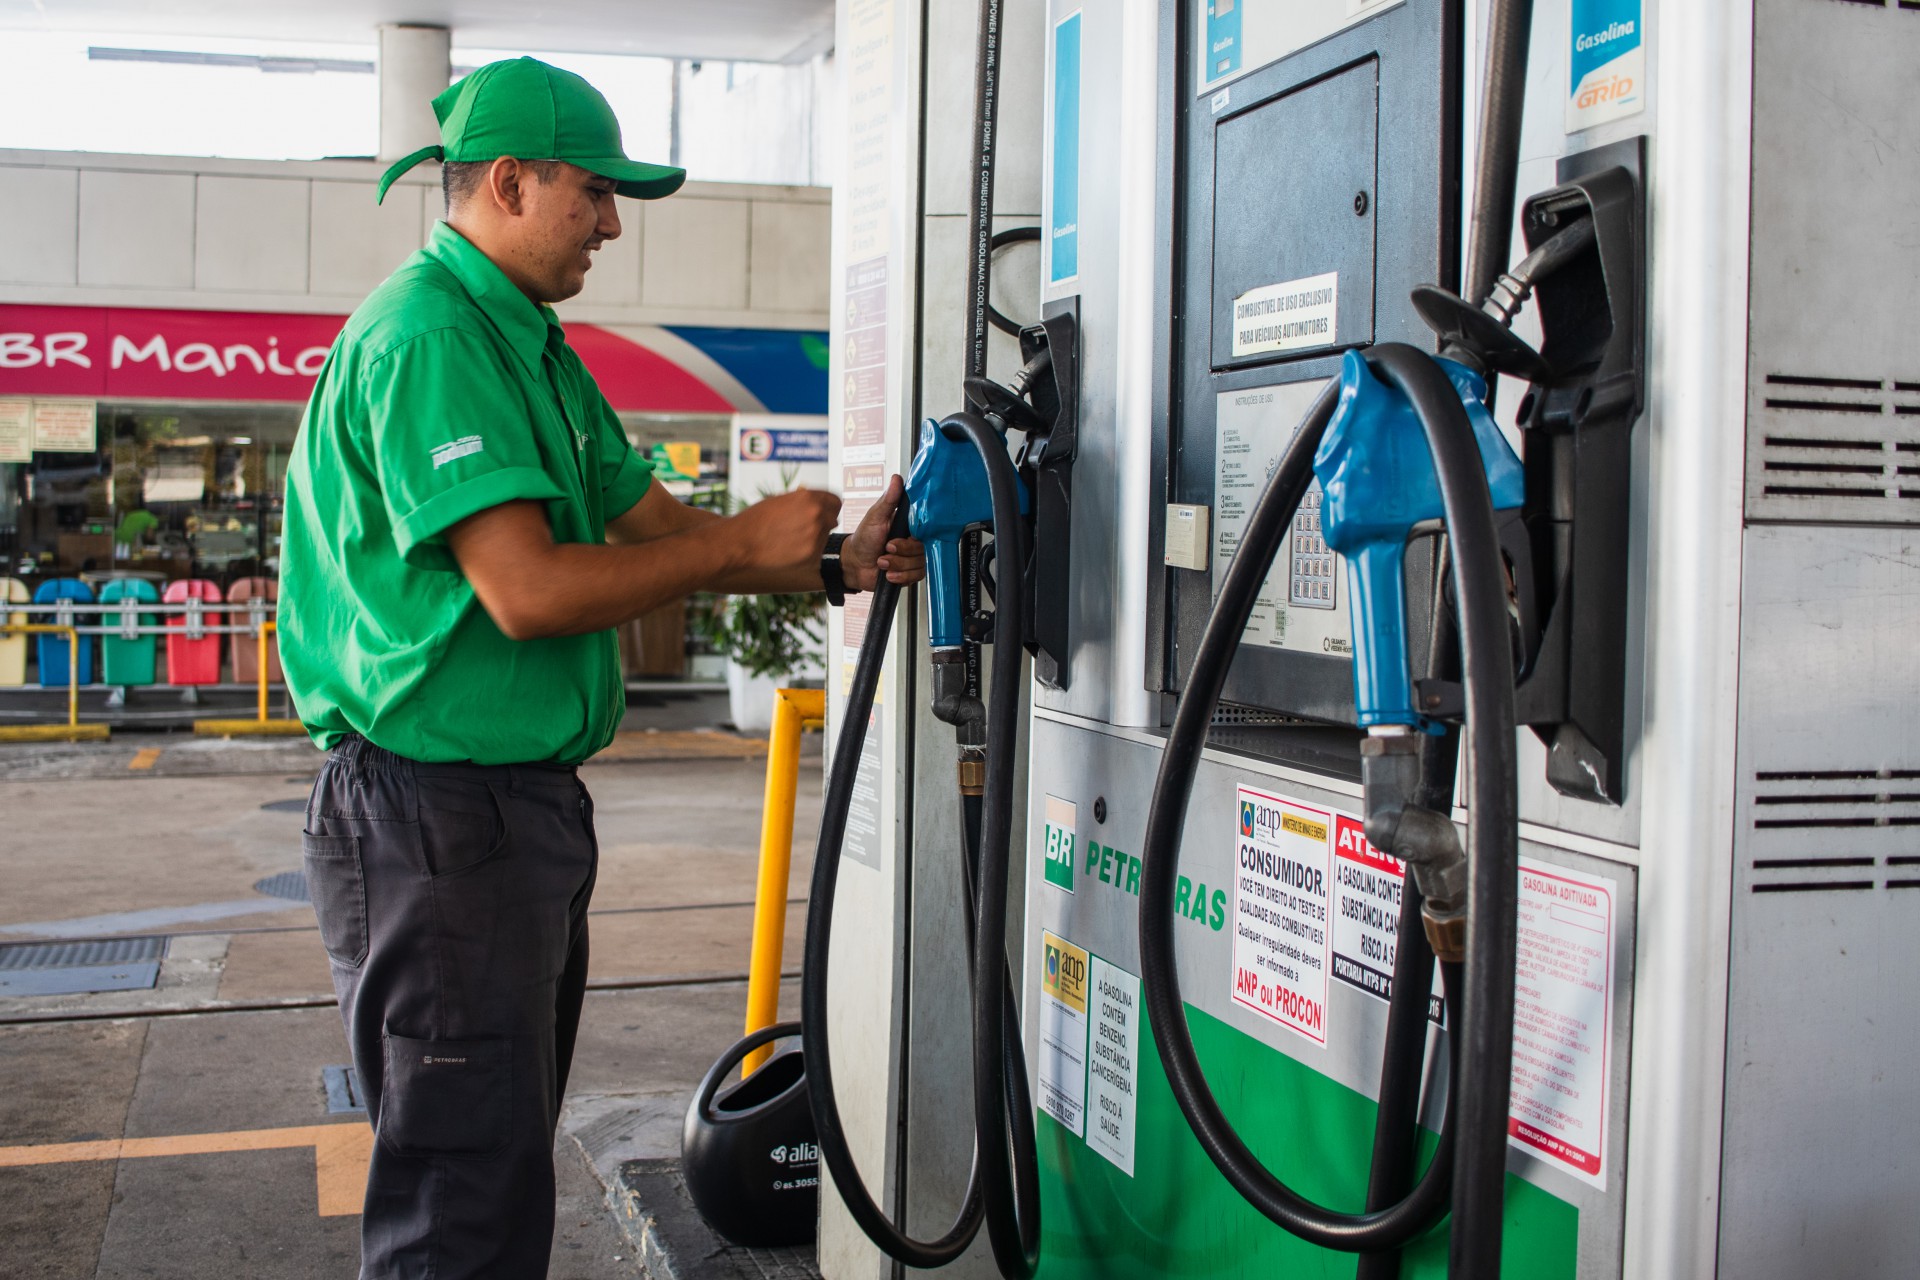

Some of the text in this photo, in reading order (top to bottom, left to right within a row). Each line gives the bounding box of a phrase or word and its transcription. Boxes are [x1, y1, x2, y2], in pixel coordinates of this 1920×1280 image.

[1576, 20, 1635, 52] Gasolina
[982, 121, 992, 152] BOMBA
[982, 155, 990, 167] DE
[1054, 222, 1077, 239] Gasolina
[1237, 288, 1333, 319] COMBUSTÍVEL DE USO EXCLUSIVO
[1239, 317, 1328, 345] PARA VEÍCULOS AUTOMOTORES
[1256, 804, 1281, 838] anp
[1045, 826, 1227, 932] BR PETRRAS
[1240, 844, 1326, 897] CONSUMIDOR.
[1337, 864, 1402, 905] A GASOLINA CONTÉ
[1240, 876, 1325, 921] VOCÊ TEM DIREITO AO TESTE DE
[1522, 876, 1597, 908] GASOLINA ADITIVADA
[1239, 899, 1324, 946] QUALIDADE DOS COMBUSTÍVEIS
[1341, 896, 1383, 929] SUBSTÂNCIA
[1238, 922, 1261, 943] Qualquer
[1262, 932, 1300, 960] irregularidade
[1360, 934, 1381, 961] RISCO
[1061, 951, 1085, 990] anp
[1256, 954, 1265, 966] ser
[1266, 956, 1294, 981] informado
[1335, 958, 1362, 982] PORTARIA
[1363, 969, 1379, 991] MTPS
[1098, 981, 1103, 993] A
[1103, 983, 1133, 1009] GASOLINA
[1237, 967, 1322, 1031] ANP ou PROCON
[1102, 1002, 1126, 1027] CONTÉM
[1095, 1041, 1131, 1074] SUBSTÂNCIA
[1099, 1094, 1117, 1117] RISCO
[1100, 1116, 1121, 1141] SAÚDE.
